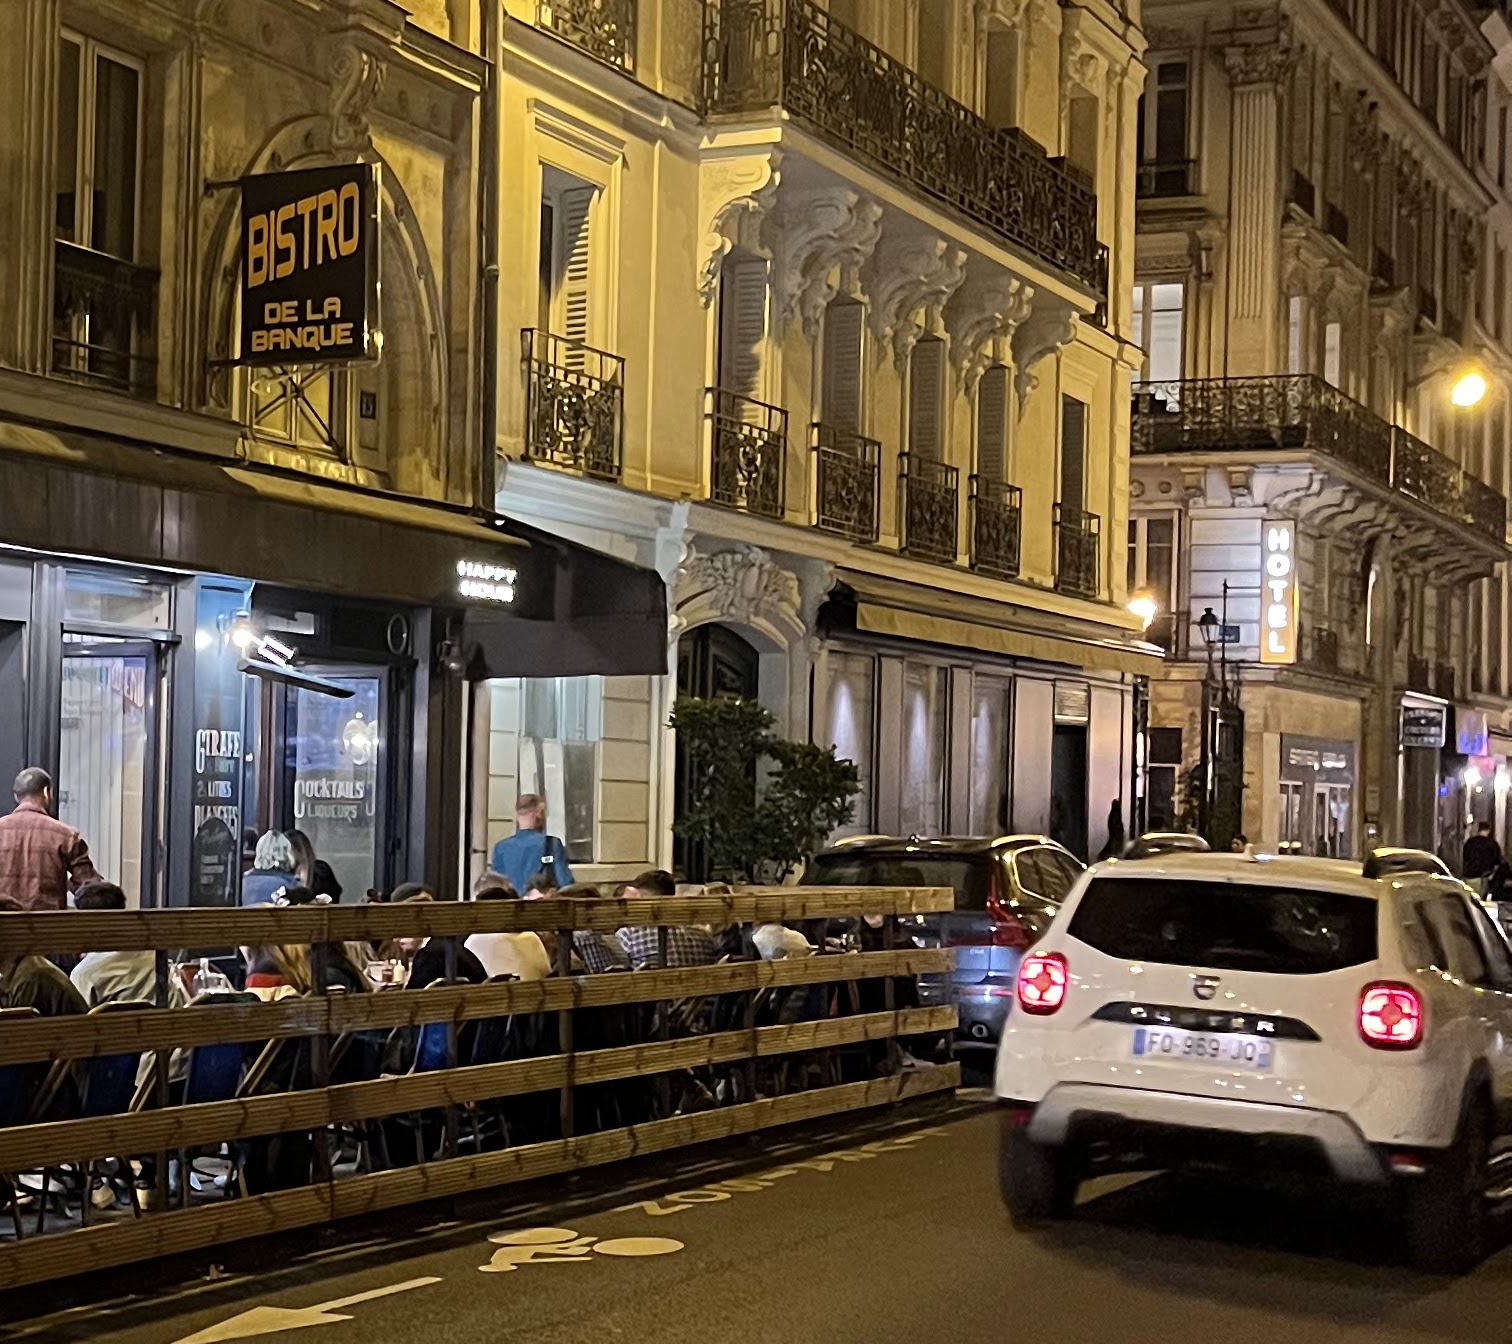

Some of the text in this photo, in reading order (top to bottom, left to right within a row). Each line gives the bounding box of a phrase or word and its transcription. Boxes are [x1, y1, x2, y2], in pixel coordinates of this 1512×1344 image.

[248, 182, 360, 289] BISTRO
[264, 296, 341, 324] DE LA
[251, 322, 354, 352] BANQUE
[456, 560, 517, 585] HAPPY
[459, 579, 514, 603] HOUR
[1265, 527, 1292, 654] HOTEL
[294, 777, 365, 819] COCKTAILS
